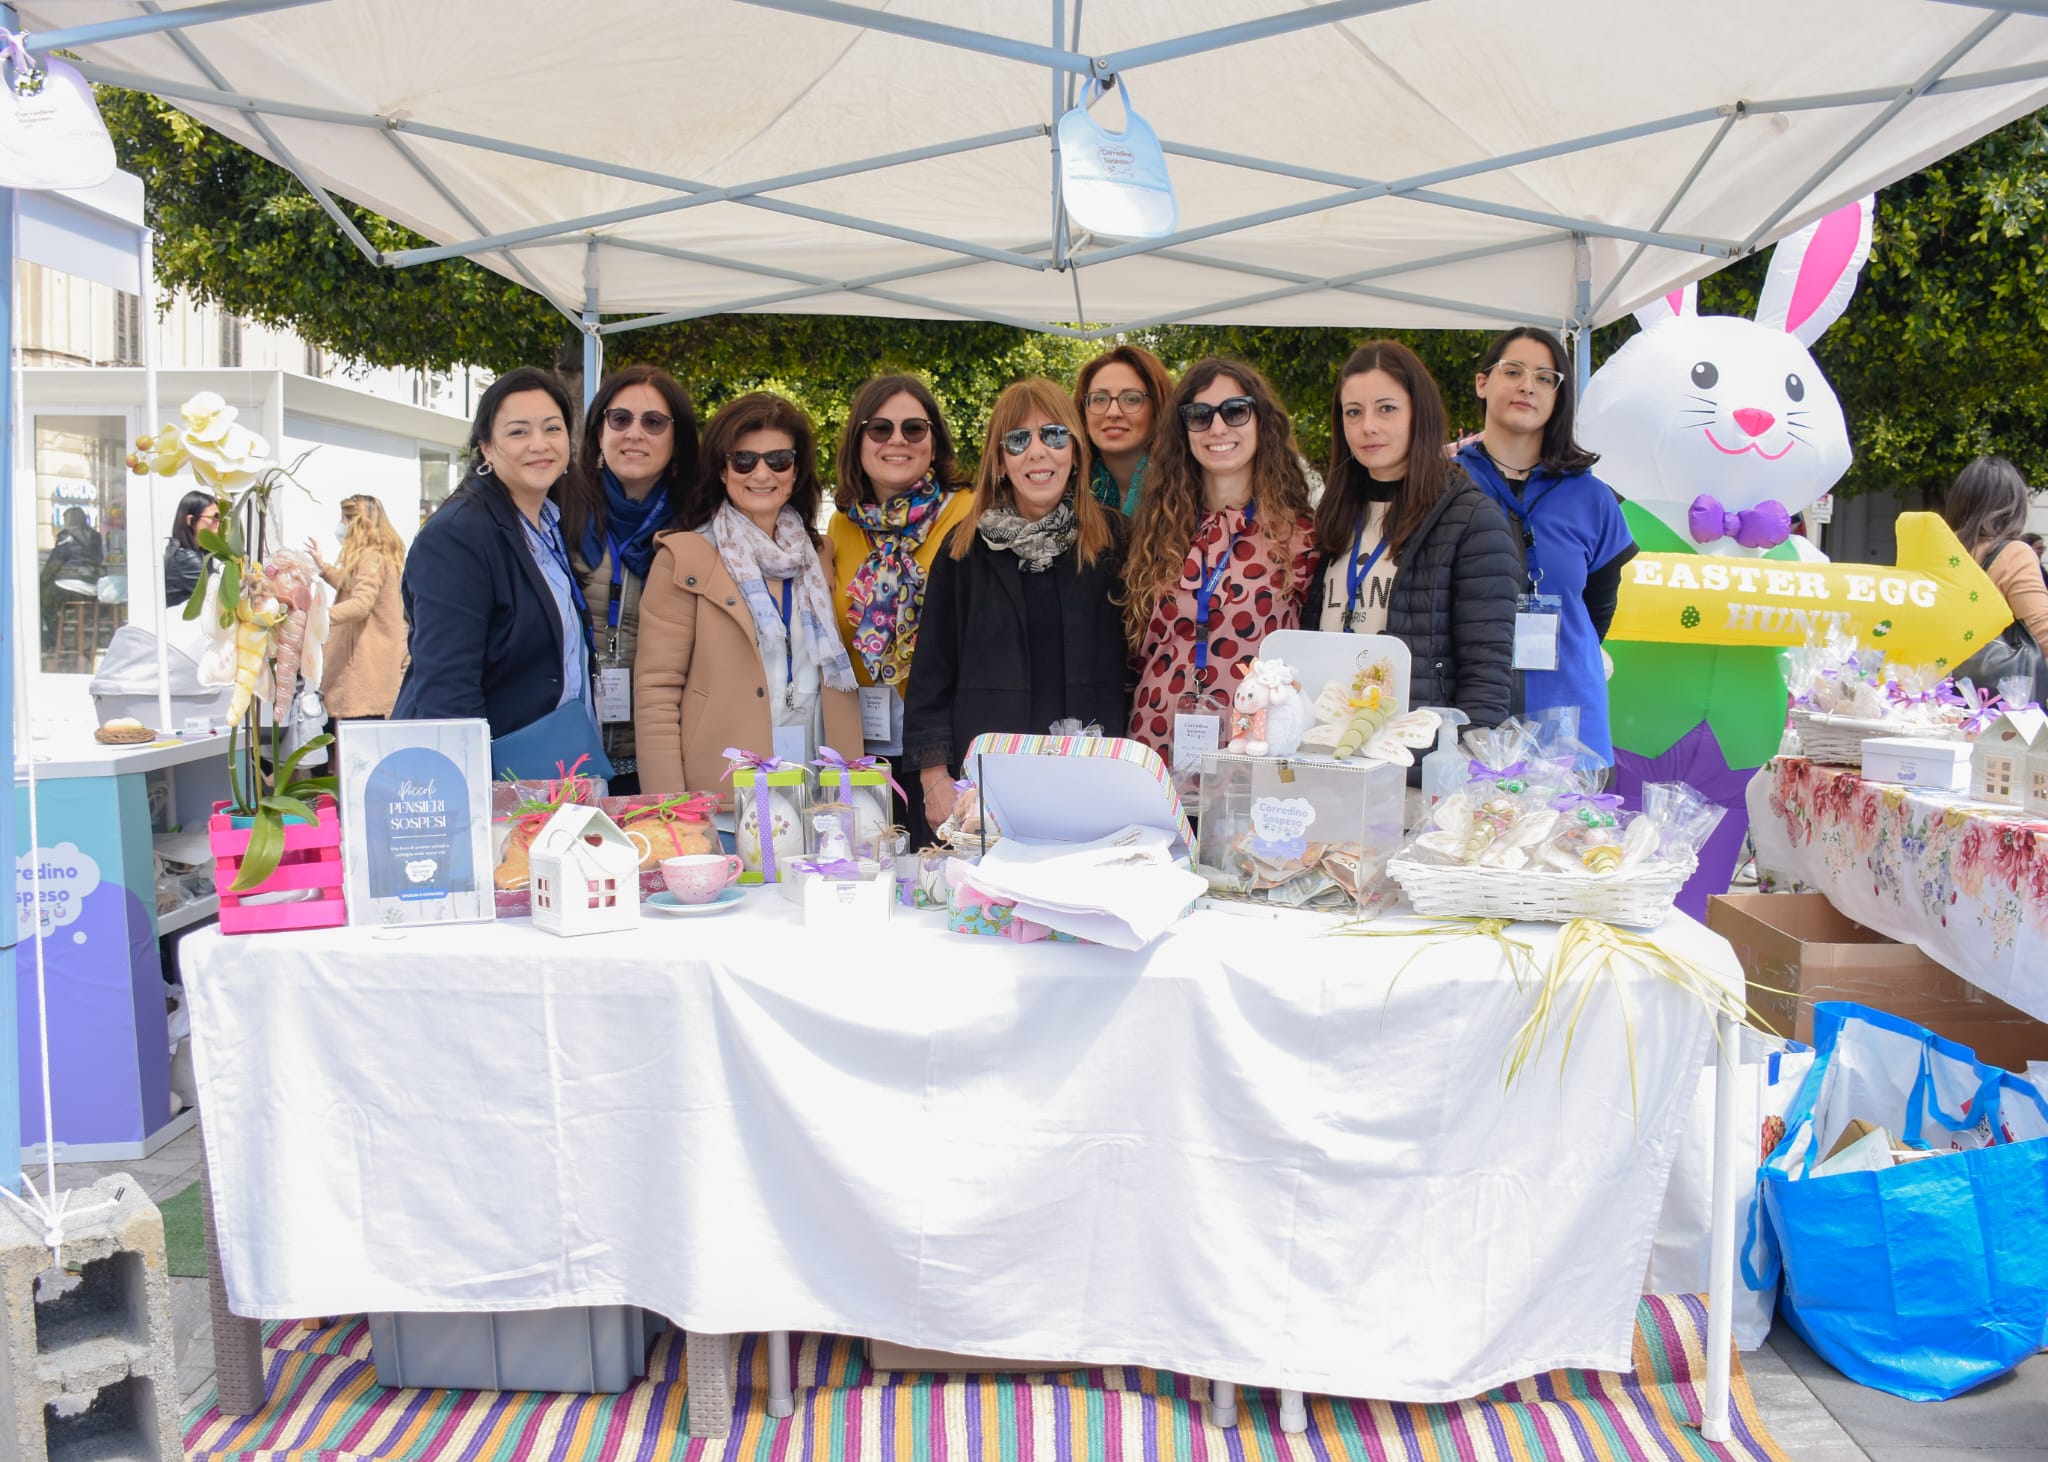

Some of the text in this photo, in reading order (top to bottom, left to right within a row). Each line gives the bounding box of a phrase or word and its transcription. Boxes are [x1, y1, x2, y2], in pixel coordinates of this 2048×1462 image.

[1632, 559, 1938, 608] EASTER EGG
[1723, 602, 1851, 636] HUNT
[389, 799, 445, 815] PENSIERI
[1259, 802, 1309, 818] Corredino
[391, 815, 447, 831] SOSPESI
[1263, 813, 1303, 828] Sospeso
